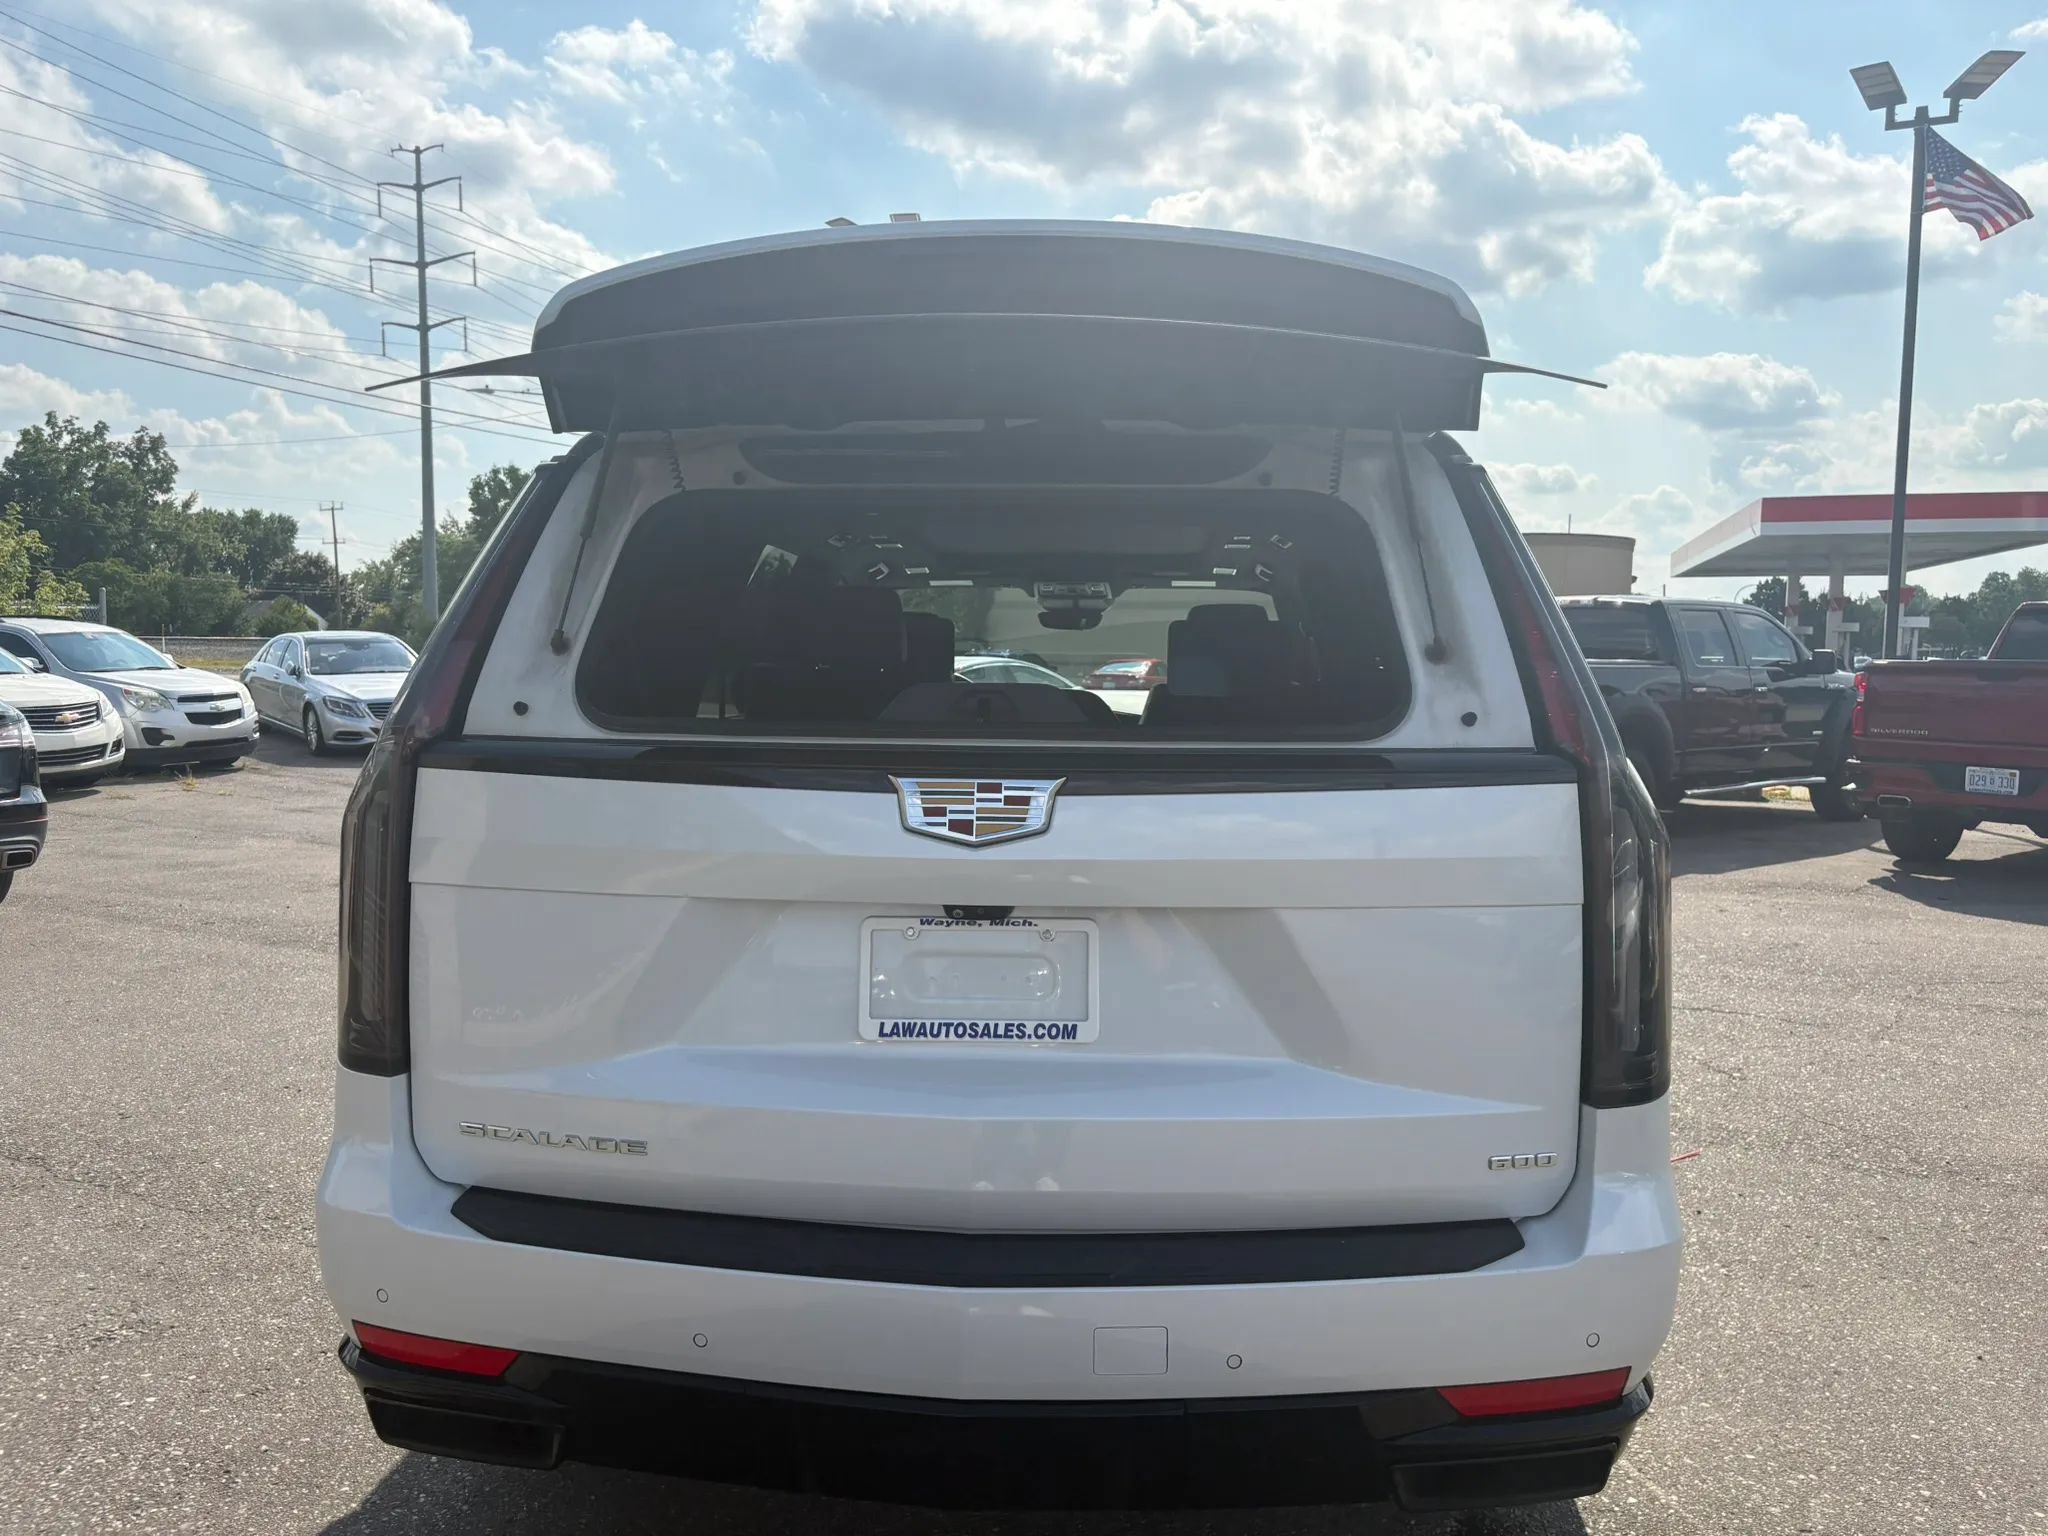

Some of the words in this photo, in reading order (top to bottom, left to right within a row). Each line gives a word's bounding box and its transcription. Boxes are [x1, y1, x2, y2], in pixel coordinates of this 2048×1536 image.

[919, 918, 983, 928] Wayne,
[989, 918, 1039, 928] Mich.
[878, 1021, 1078, 1040] LAWAUTOSALES.COM
[1488, 1152, 1557, 1170] 600
